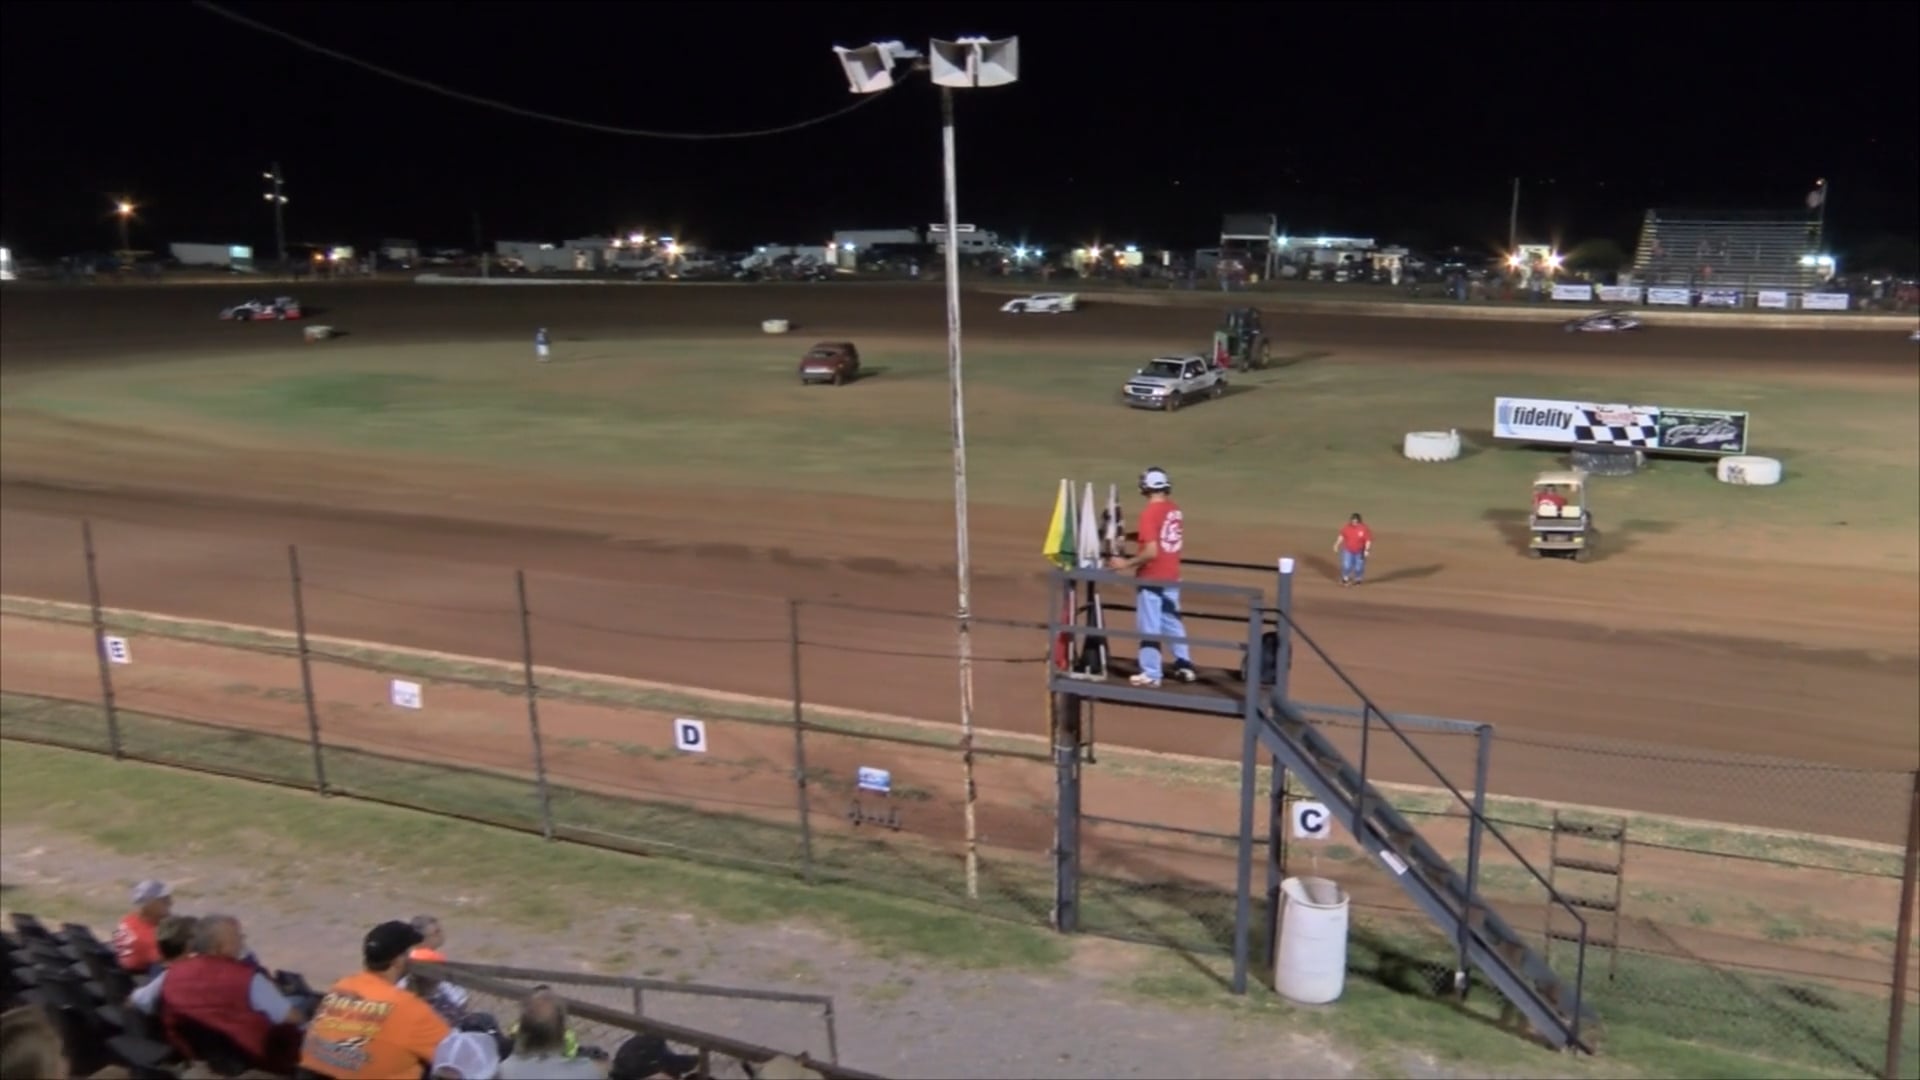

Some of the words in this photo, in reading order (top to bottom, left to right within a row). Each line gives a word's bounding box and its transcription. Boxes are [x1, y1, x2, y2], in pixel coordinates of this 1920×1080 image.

[1513, 406, 1573, 430] fidelity
[110, 641, 124, 658] E
[682, 724, 700, 745] D
[1300, 809, 1323, 833] C
